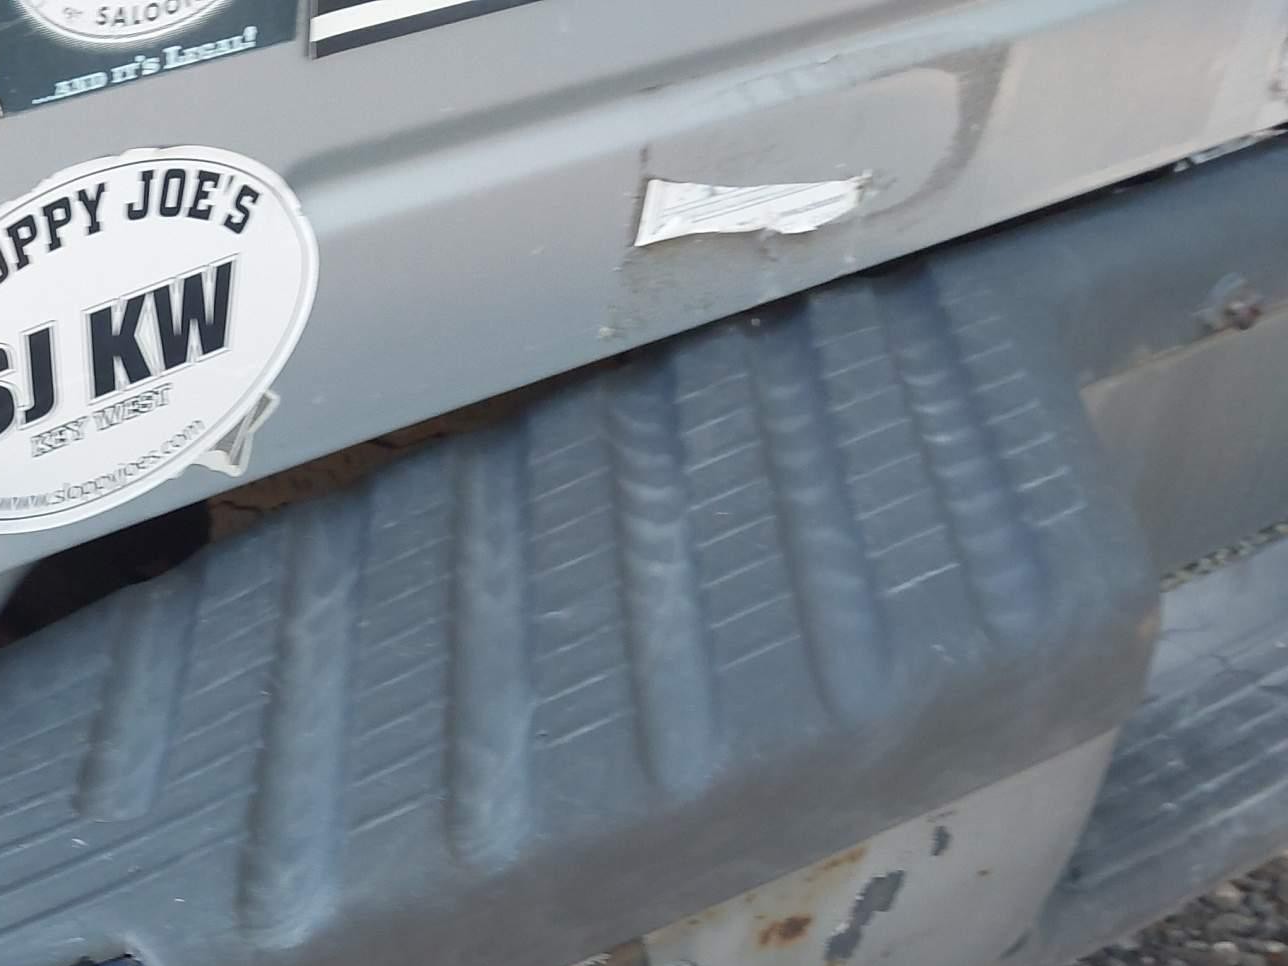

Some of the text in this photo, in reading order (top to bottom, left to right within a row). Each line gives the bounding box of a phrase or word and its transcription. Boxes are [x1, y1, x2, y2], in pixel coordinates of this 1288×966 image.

[127, 168, 261, 234] JOE'S
[87, 259, 235, 399] KW
[30, 382, 173, 457] KEY WEST
